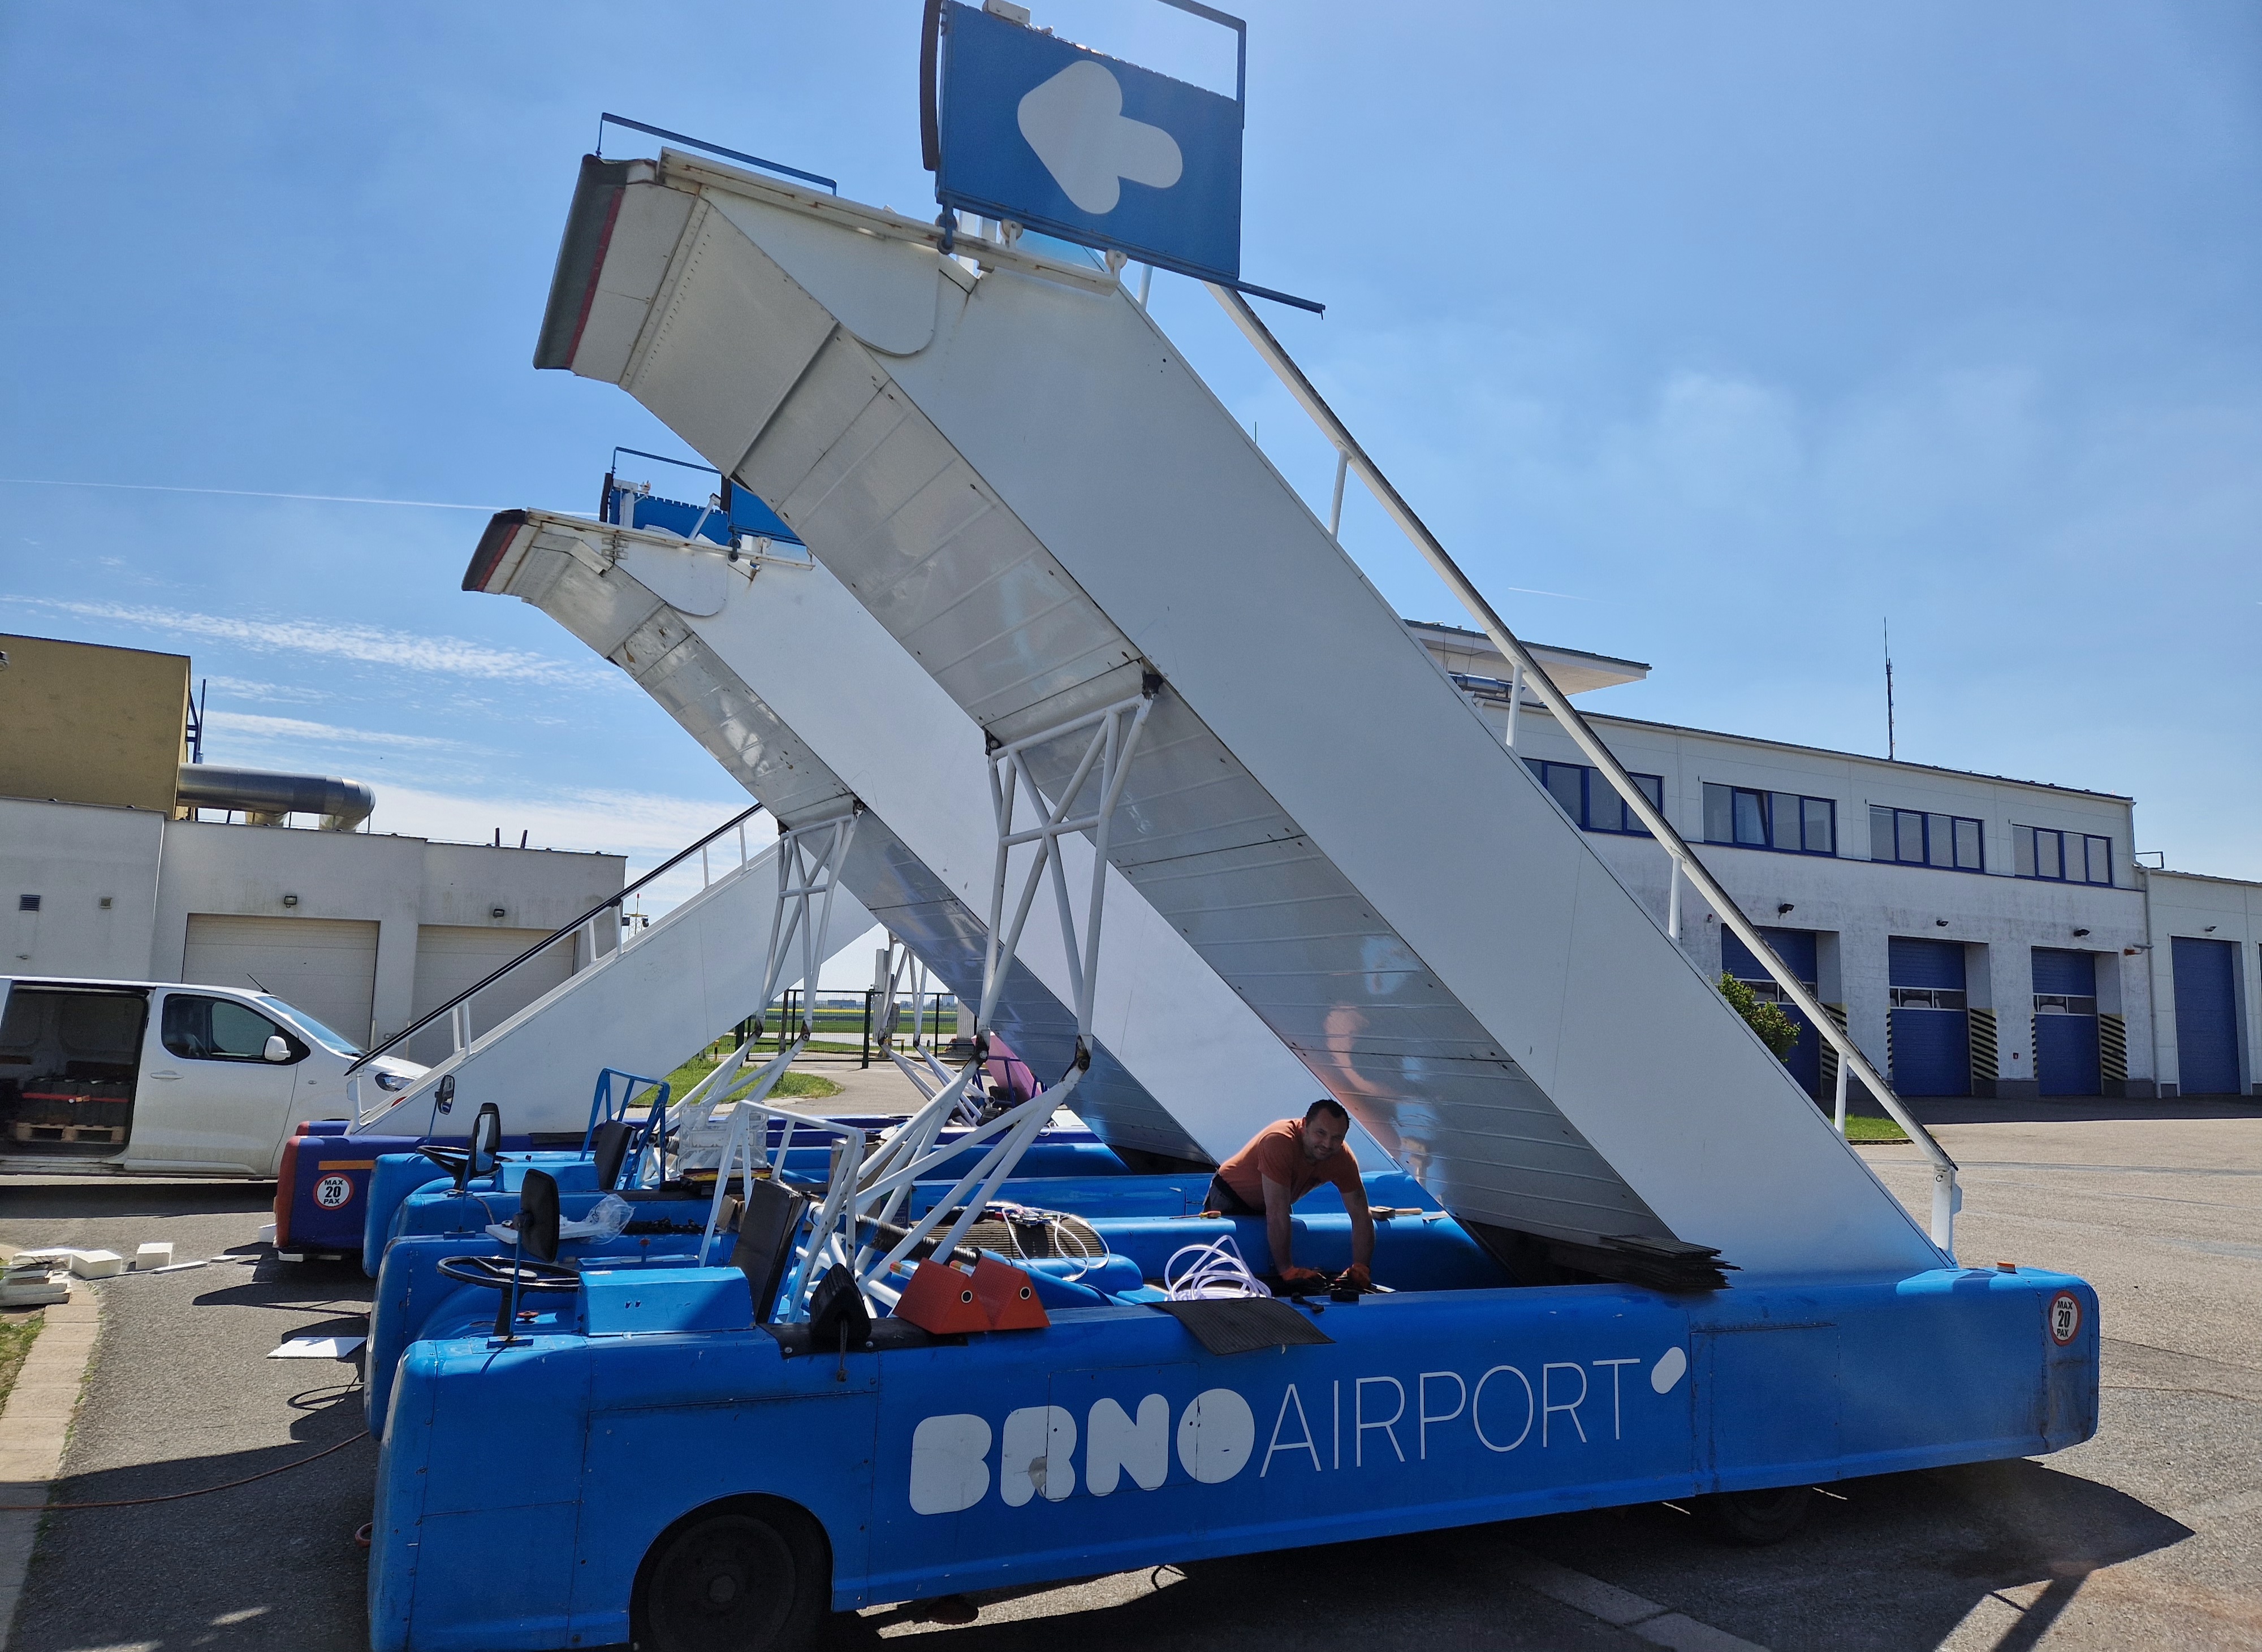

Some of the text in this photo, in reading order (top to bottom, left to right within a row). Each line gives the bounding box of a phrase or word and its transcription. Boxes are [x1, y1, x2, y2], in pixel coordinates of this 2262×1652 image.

[325, 1186, 342, 1198] 20
[2057, 1301, 2073, 1309] MAX
[2058, 1310, 2071, 1328] 20
[2057, 1329, 2069, 1337] PAX
[909, 1358, 1641, 1515] BRNO AIRPORT
